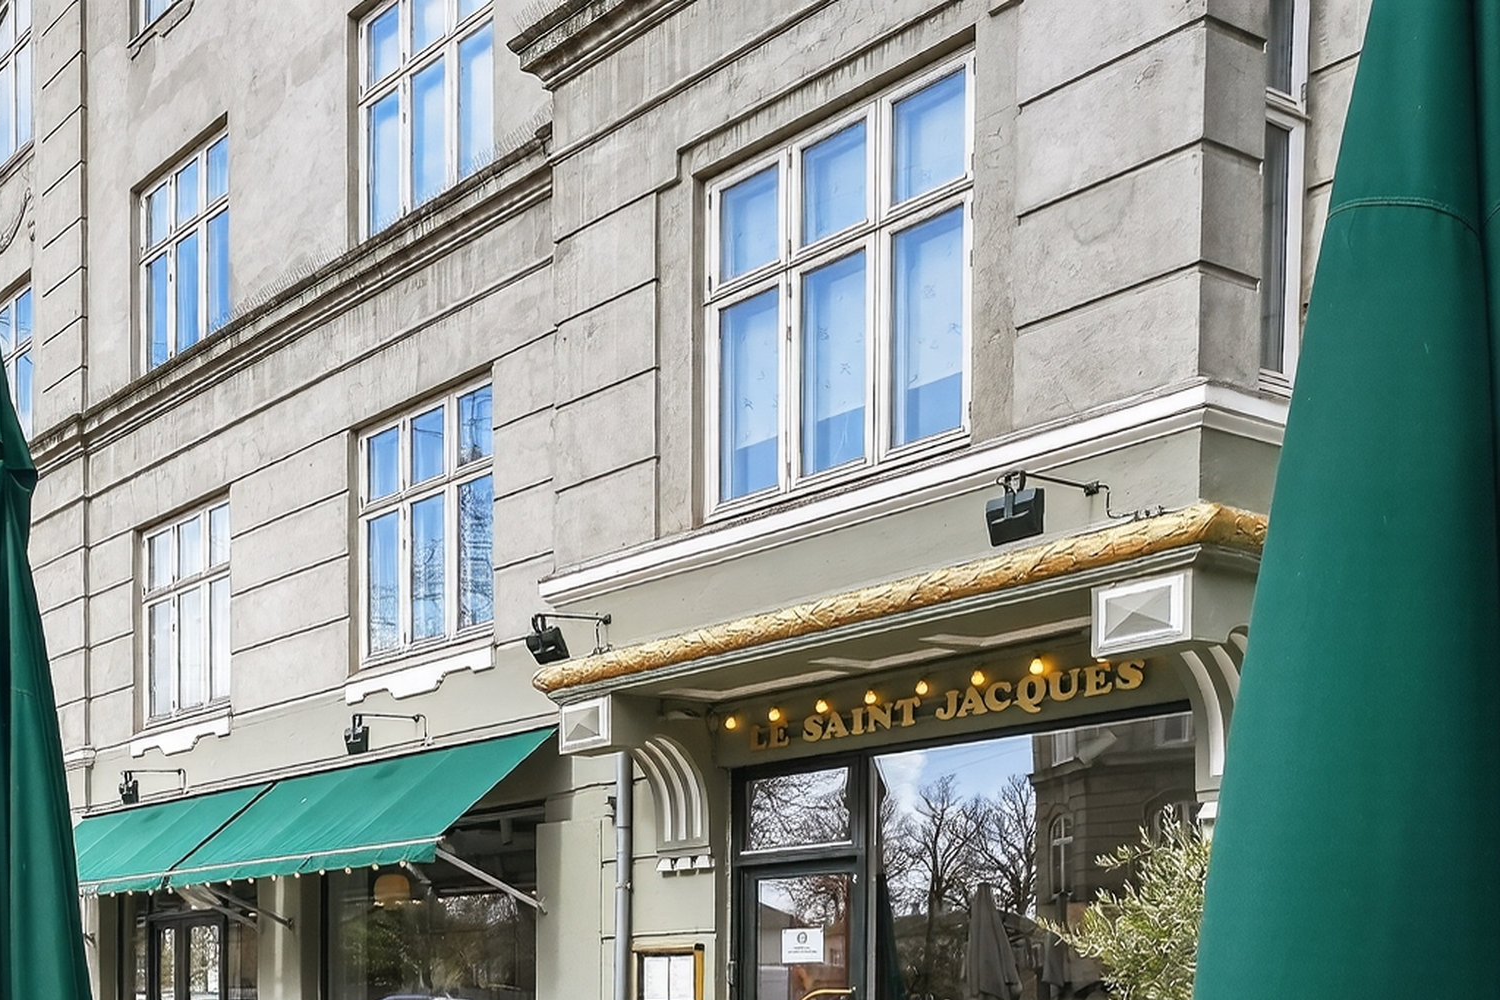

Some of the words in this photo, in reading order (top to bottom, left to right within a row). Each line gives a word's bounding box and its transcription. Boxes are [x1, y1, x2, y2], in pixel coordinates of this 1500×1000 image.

[752, 722, 790, 750] LE
[802, 696, 921, 743] SAINT
[934, 659, 1146, 721] JACQUES
